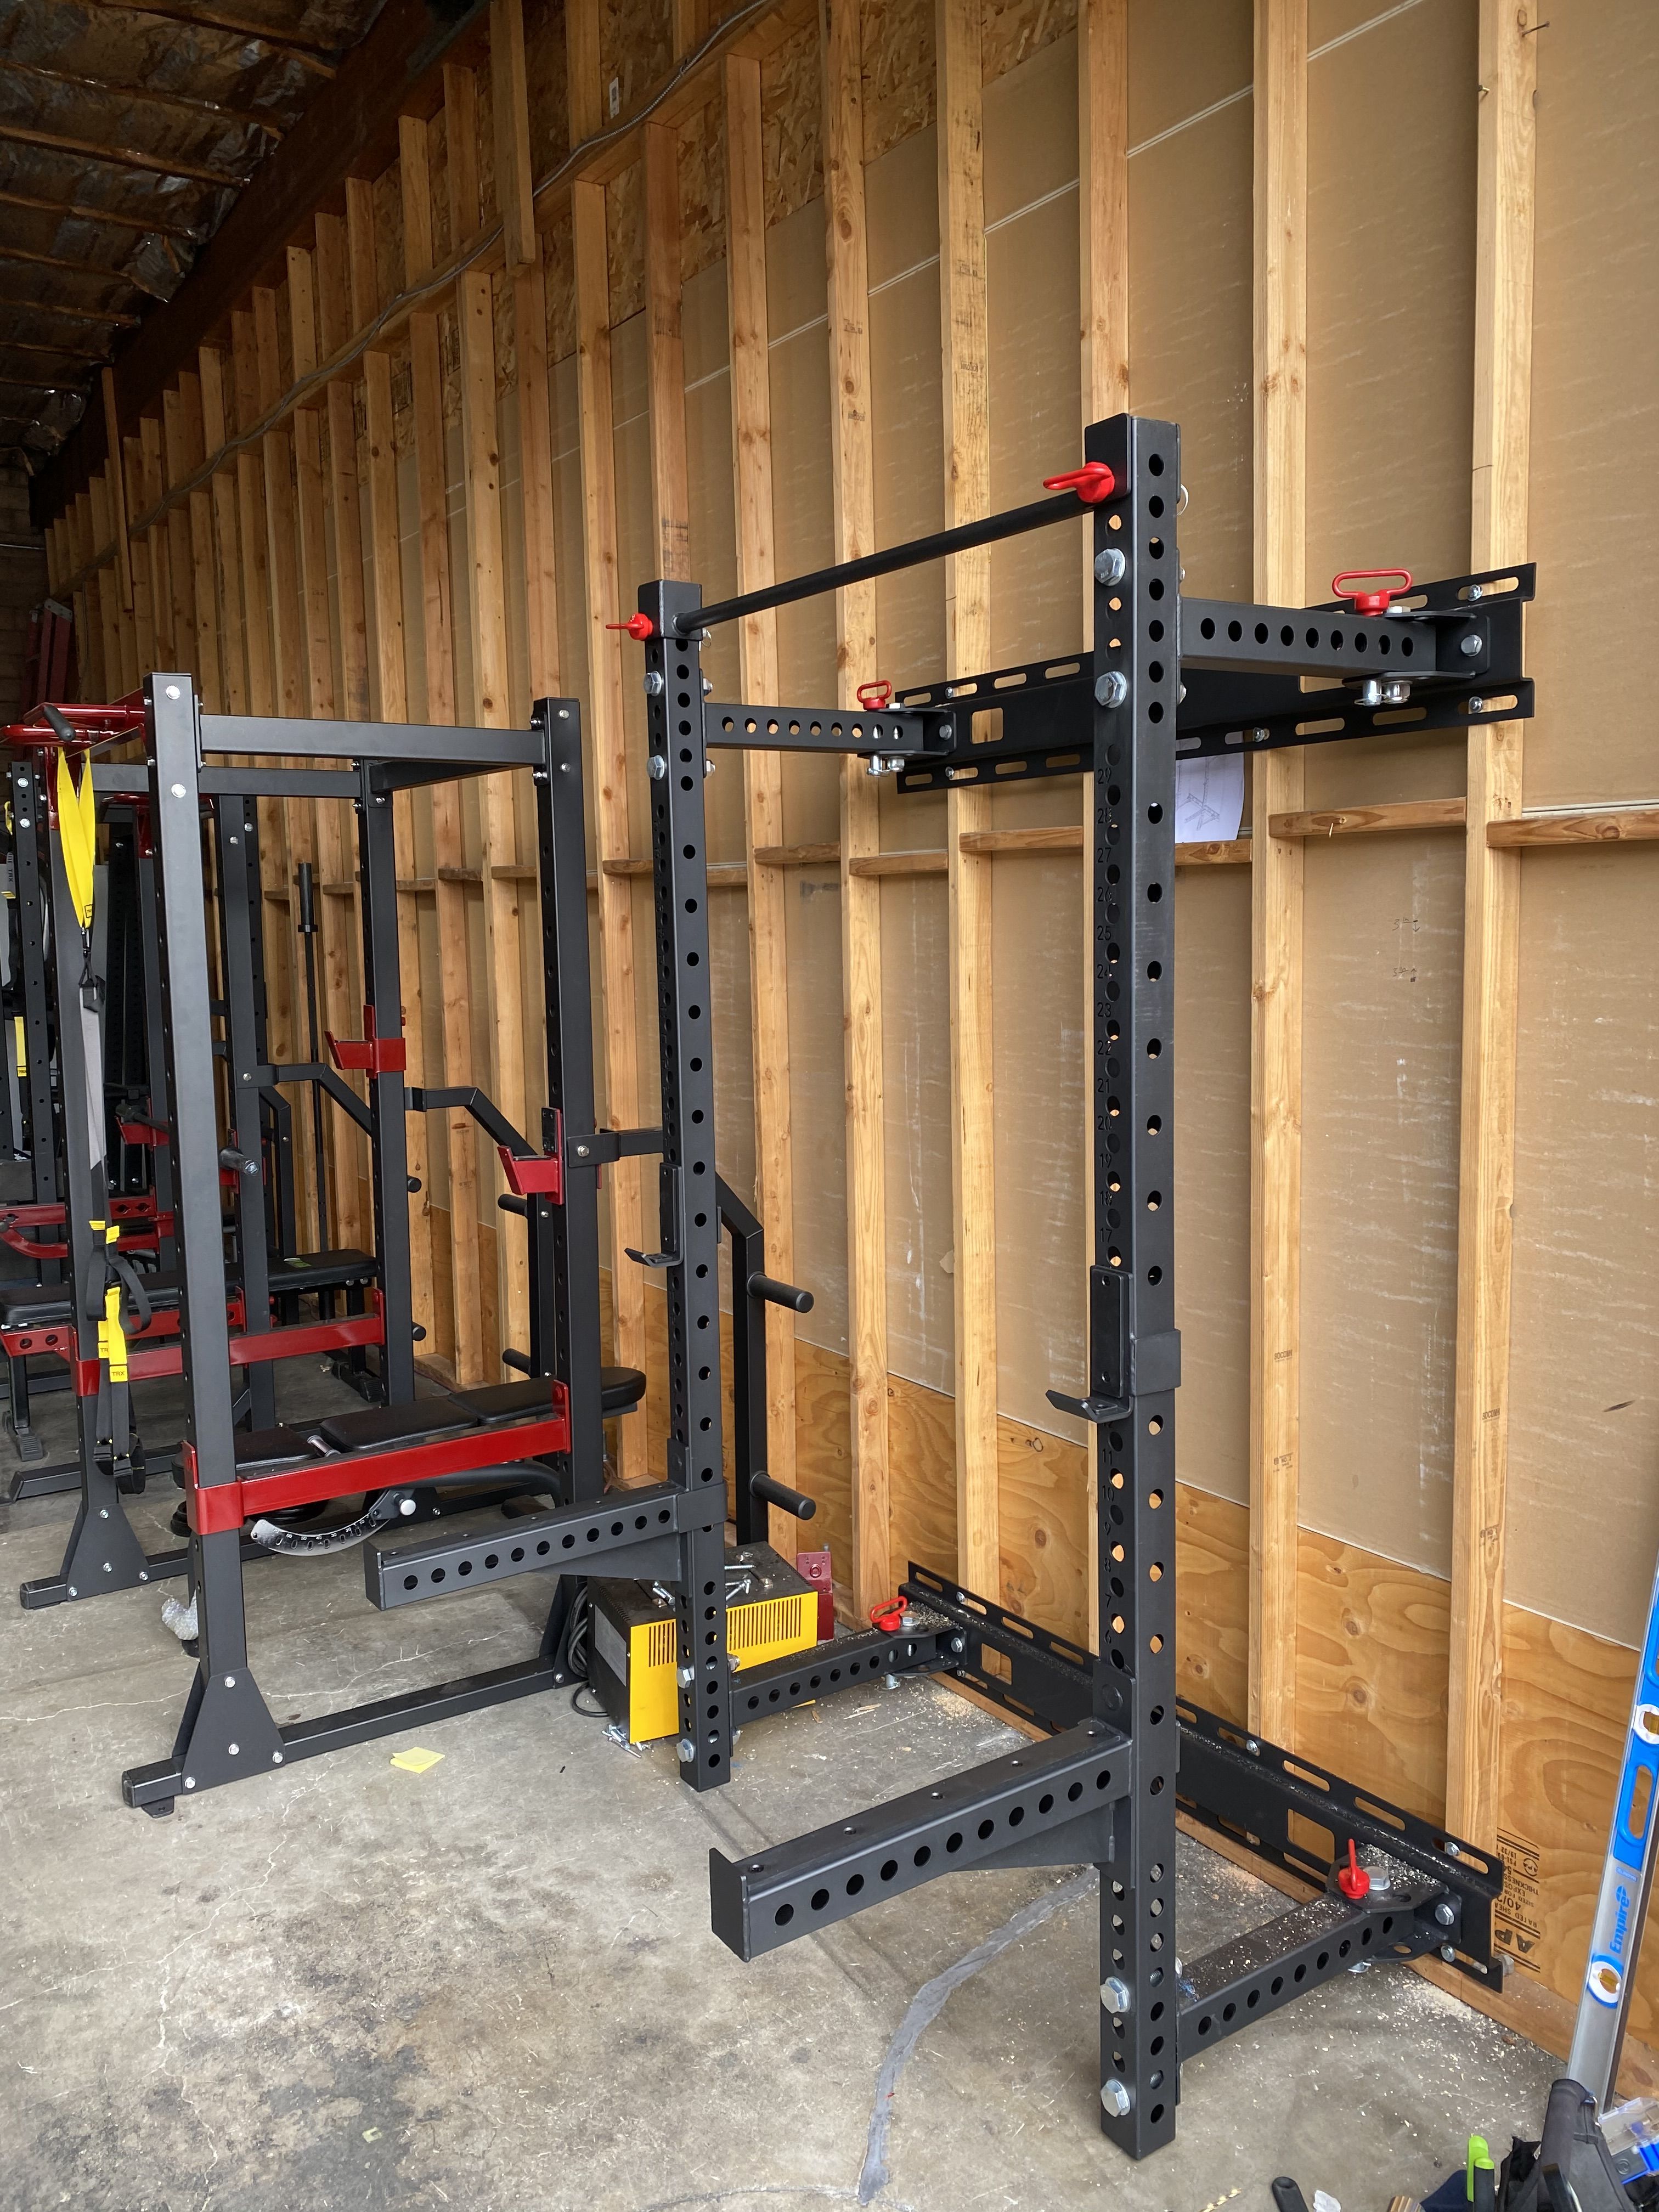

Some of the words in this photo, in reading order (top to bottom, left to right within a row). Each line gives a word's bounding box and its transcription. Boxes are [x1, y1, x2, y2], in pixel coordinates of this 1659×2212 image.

[1098, 768, 1111, 785] 29
[1097, 847, 1111, 864] 27
[1097, 886, 1112, 902] 26
[1097, 925, 1112, 941] 25
[1097, 964, 1113, 980] 24
[1097, 1002, 1112, 1017] 23
[1097, 1040, 1112, 1056] 22
[1097, 1078, 1110, 1093] 21
[1097, 1115, 1112, 1131] 20
[1098, 1154, 1112, 1169] 19
[1099, 1191, 1113, 1206] 18
[1099, 1228, 1113, 1243] 17
[1102, 1448, 1113, 1465] 11
[1102, 1485, 1114, 1502] 10
[1104, 1521, 1111, 1536] 9
[1103, 1558, 1111, 1572] 8
[1104, 1593, 1112, 1607] 7
[1104, 1629, 1112, 1644] 6
[1501, 1846, 1517, 1859] 19/32
[1504, 1873, 1539, 1896] THICKNESS
[1504, 1889, 1515, 1899] FOR
[1518, 1895, 1534, 1908] SIZED
[1515, 1912, 1538, 1928] RATED
[1609, 1891, 1631, 1954] Empire
